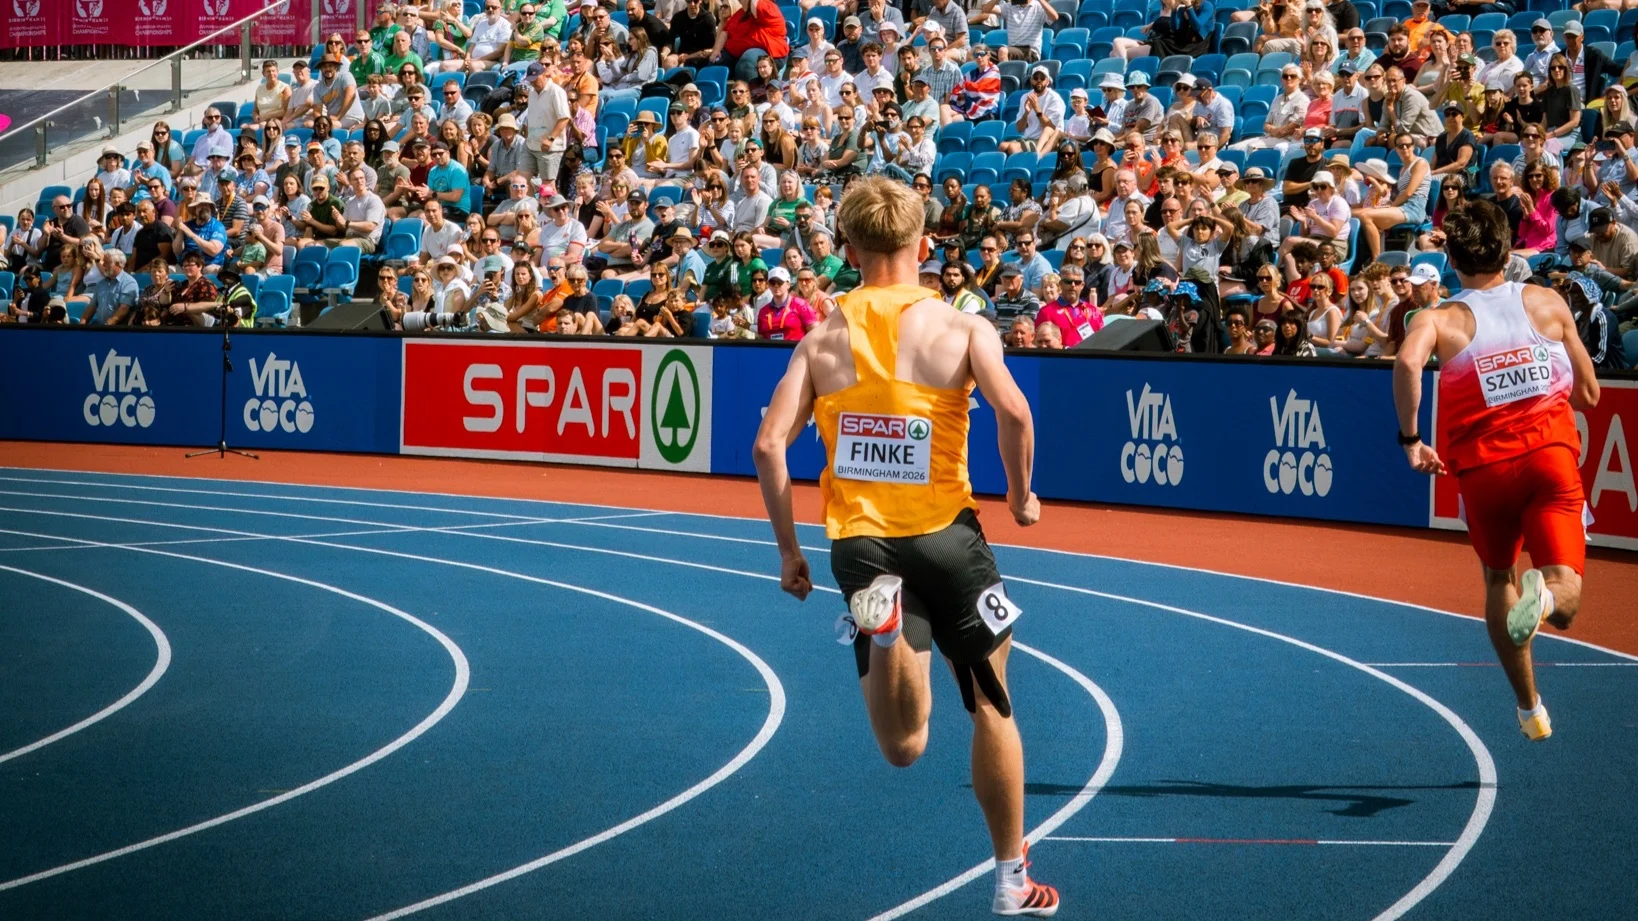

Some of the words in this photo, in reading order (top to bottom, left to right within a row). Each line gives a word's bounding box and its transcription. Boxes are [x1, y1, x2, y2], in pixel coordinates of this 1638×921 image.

[89, 348, 148, 393] VITA
[248, 351, 307, 398] VITA
[1478, 350, 1532, 372] SPAR
[1486, 366, 1550, 392] SZWED
[1488, 386, 1540, 404] BIRMINGHAM
[83, 394, 156, 428] COCO
[243, 398, 315, 433] COCO
[462, 363, 636, 440] SPAR
[1126, 382, 1178, 441] VITA
[1269, 388, 1326, 449] VITA
[843, 416, 905, 437] SPAR
[850, 441, 916, 465] FINKE
[1120, 441, 1184, 486] COCO
[837, 465, 901, 480] BIRMINGHAM
[902, 470, 926, 481] 2026
[1263, 449, 1333, 497] COCO
[985, 592, 1009, 622] 8
